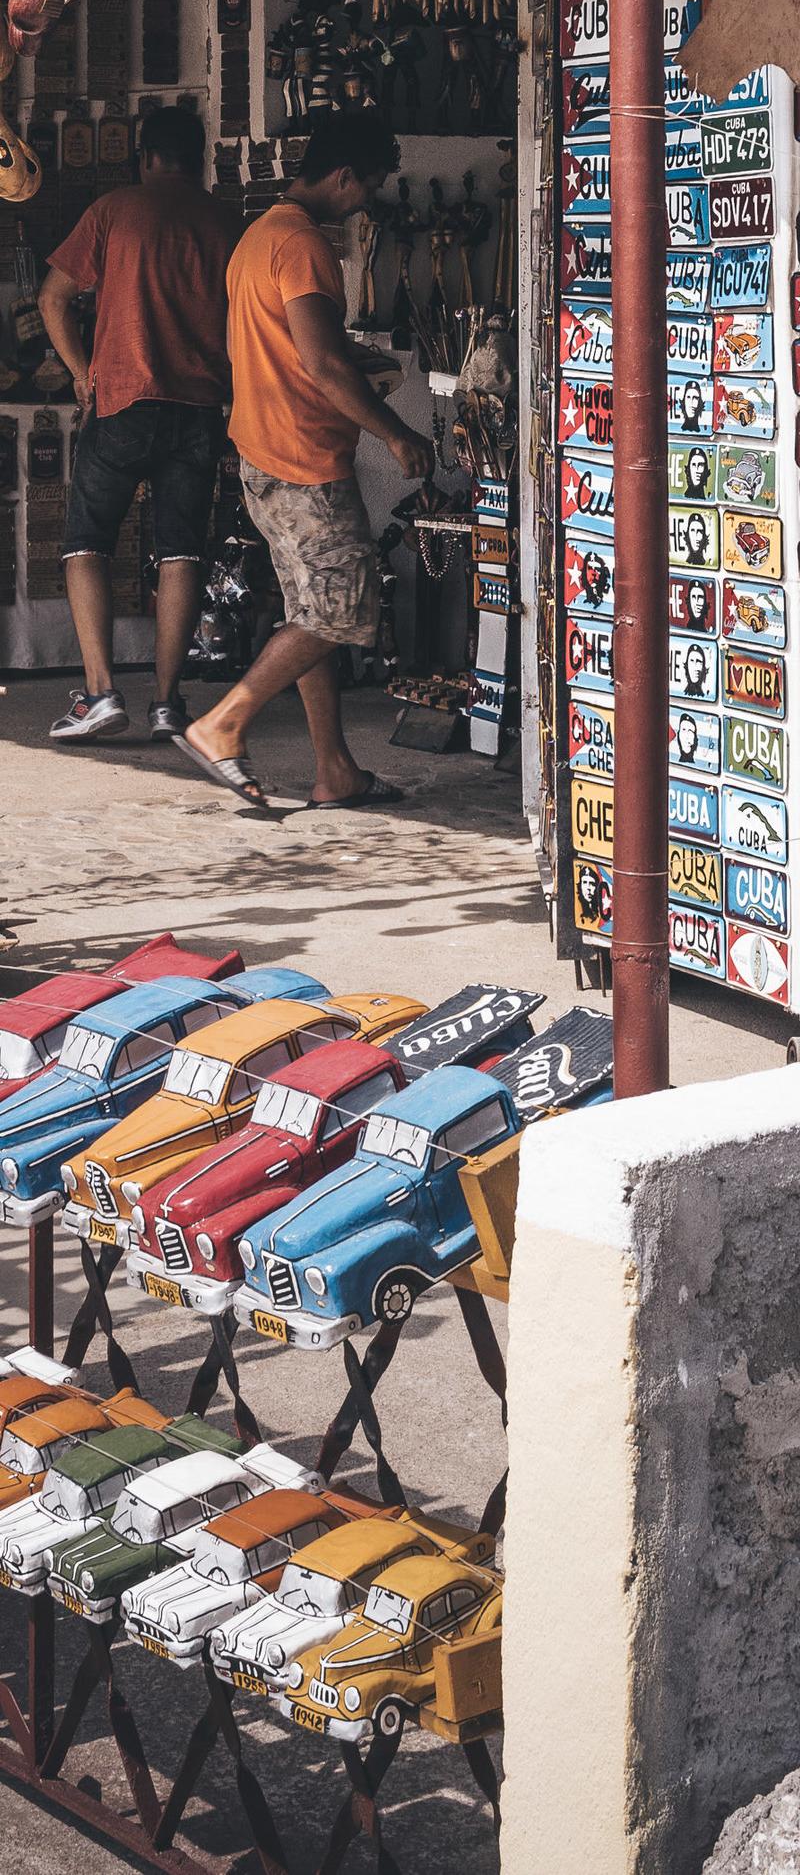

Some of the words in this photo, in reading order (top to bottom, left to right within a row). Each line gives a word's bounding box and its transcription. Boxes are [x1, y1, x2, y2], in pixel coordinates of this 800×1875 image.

[725, 116, 746, 130] CUBA
[731, 182, 751, 194] CUBA
[668, 191, 705, 241] UBA
[712, 193, 771, 228] SDV417
[715, 261, 767, 298] HCU741
[667, 325, 708, 361] CUBA
[482, 487, 505, 509] TAXI
[569, 629, 609, 676] CHE
[725, 653, 735, 696] I
[744, 666, 782, 703] CUBA
[588, 747, 613, 775] CHE
[732, 724, 782, 780] CUBA
[576, 797, 613, 843] CHE
[669, 788, 711, 829] CUBA
[738, 826, 768, 855] CUBA
[670, 847, 719, 900] CUBA
[735, 869, 786, 923] CUBA
[673, 913, 721, 967] CUBA
[514, 1046, 555, 1110] CUBA
[93, 1222, 116, 1241] 1942
[256, 1314, 284, 1338] 1948
[237, 1674, 265, 1693] 1955
[295, 1708, 323, 1731] 1942
